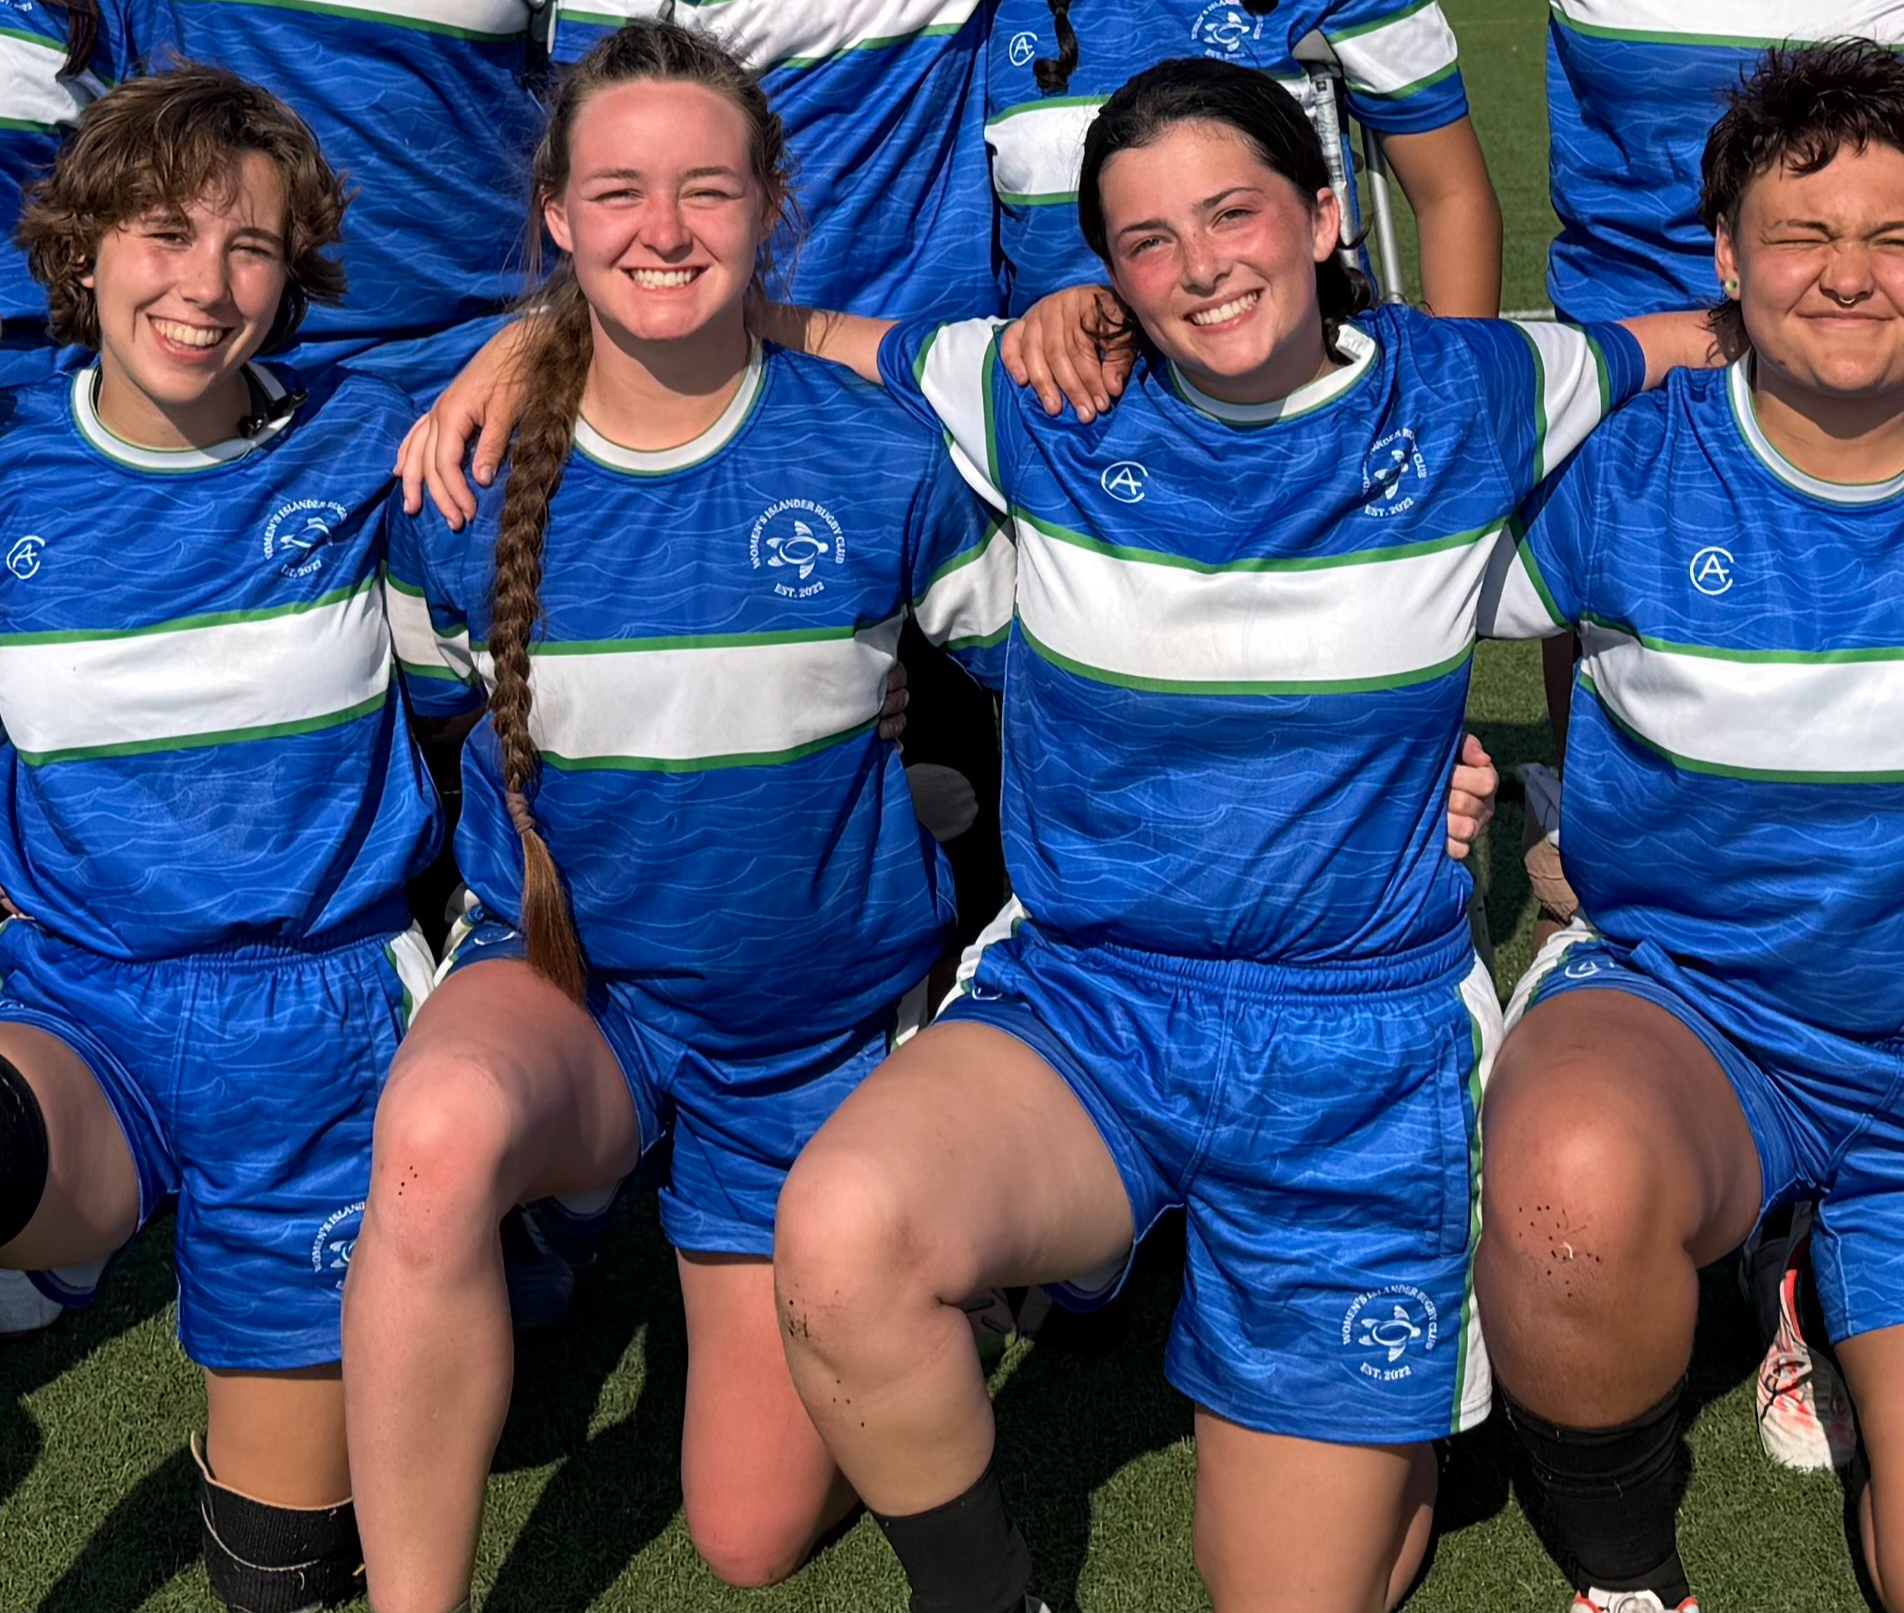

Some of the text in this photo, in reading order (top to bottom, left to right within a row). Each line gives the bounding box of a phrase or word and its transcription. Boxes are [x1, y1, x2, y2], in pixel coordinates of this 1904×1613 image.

[750, 499, 846, 570] WOMEN'S ISLANDER RUGBY CLUB
[774, 581, 825, 598] EST. 2022
[1342, 1294, 1368, 1345] WOMEN'S
